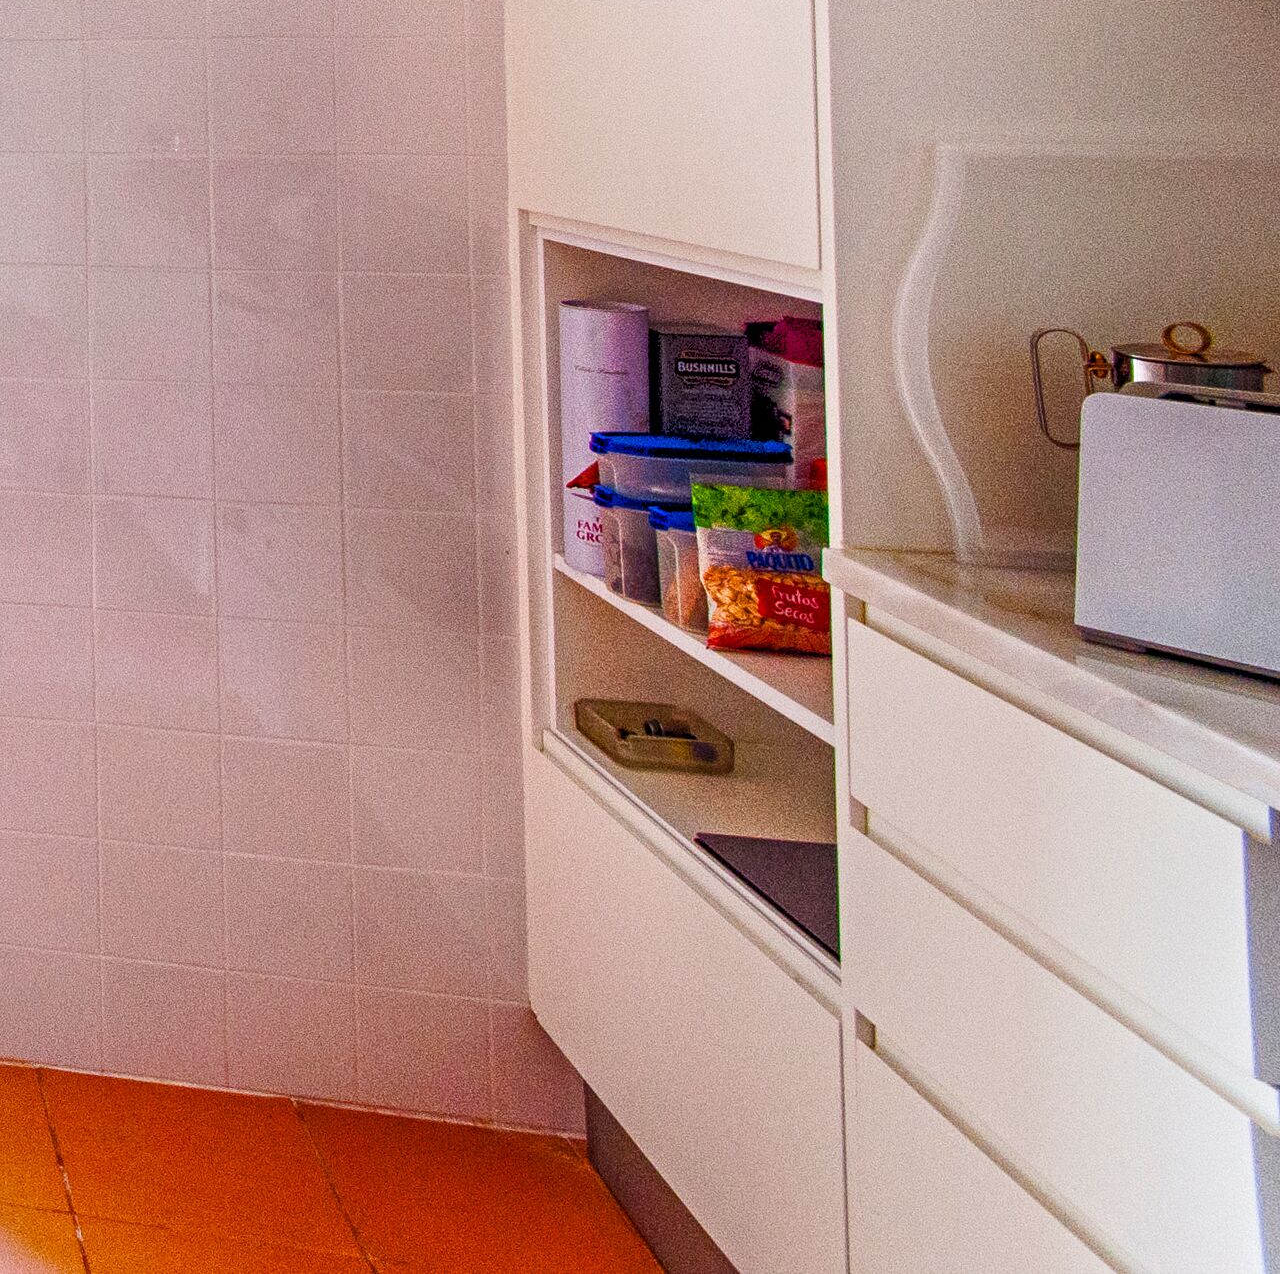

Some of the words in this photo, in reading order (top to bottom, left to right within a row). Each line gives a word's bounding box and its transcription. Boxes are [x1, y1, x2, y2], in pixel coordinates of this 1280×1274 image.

[677, 361, 736, 374] BUSHMILLS
[577, 520, 603, 533] FAM
[774, 601, 815, 624] Secos
